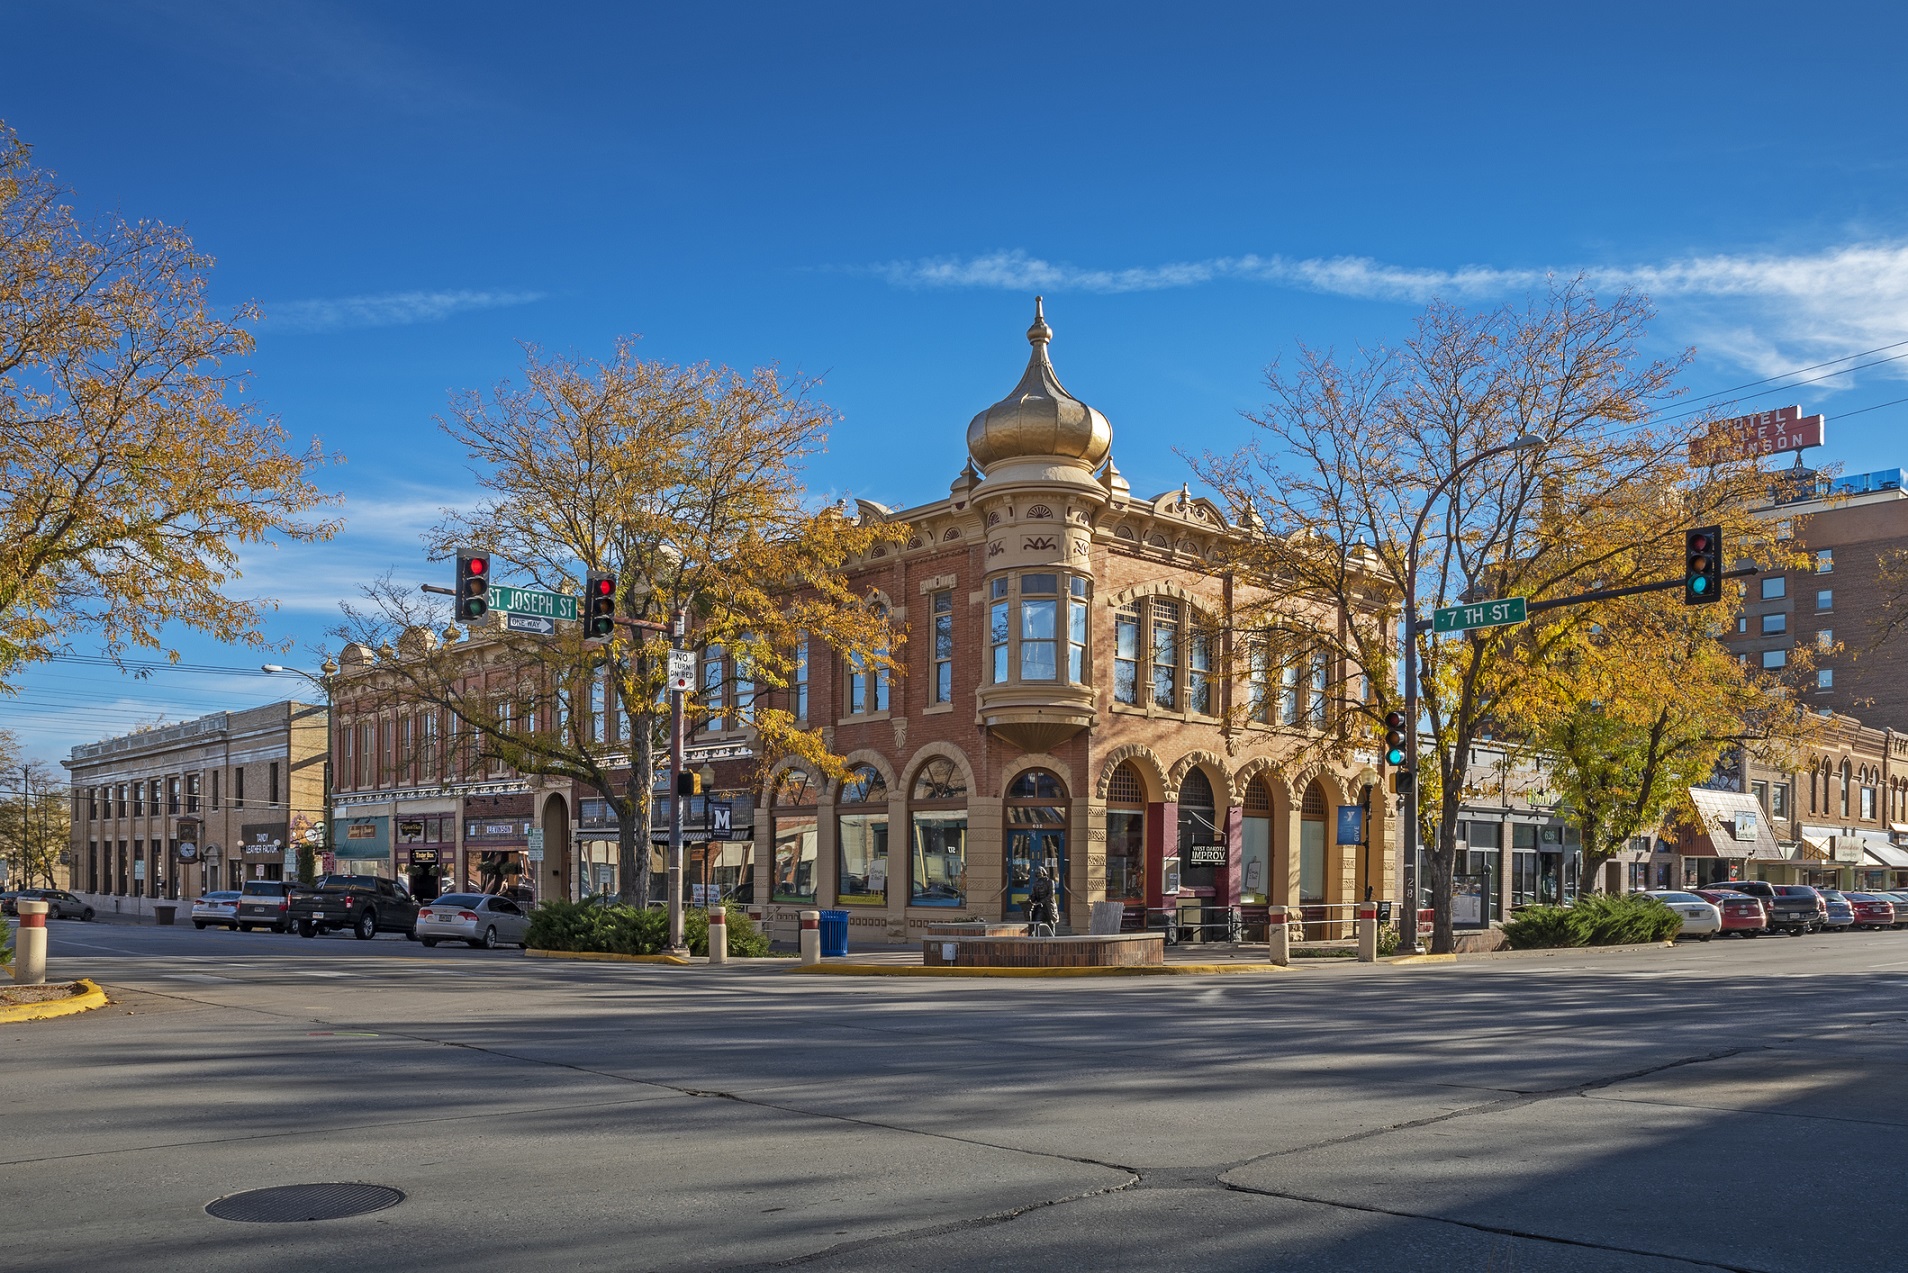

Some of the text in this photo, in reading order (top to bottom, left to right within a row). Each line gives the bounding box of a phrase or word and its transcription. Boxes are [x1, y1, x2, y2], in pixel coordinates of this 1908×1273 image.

[488, 587, 573, 617] ST JOSEPH ST
[1447, 603, 1511, 627] 7 TH ST
[512, 618, 541, 628] ONE WAY
[675, 653, 688, 662] NO
[674, 662, 691, 671] TURN
[682, 671, 693, 679] RED
[714, 810, 731, 830] M
[256, 833, 269, 842] TANDY
[246, 844, 262, 854] LEATHER
[1191, 851, 1226, 860] IMPROV
